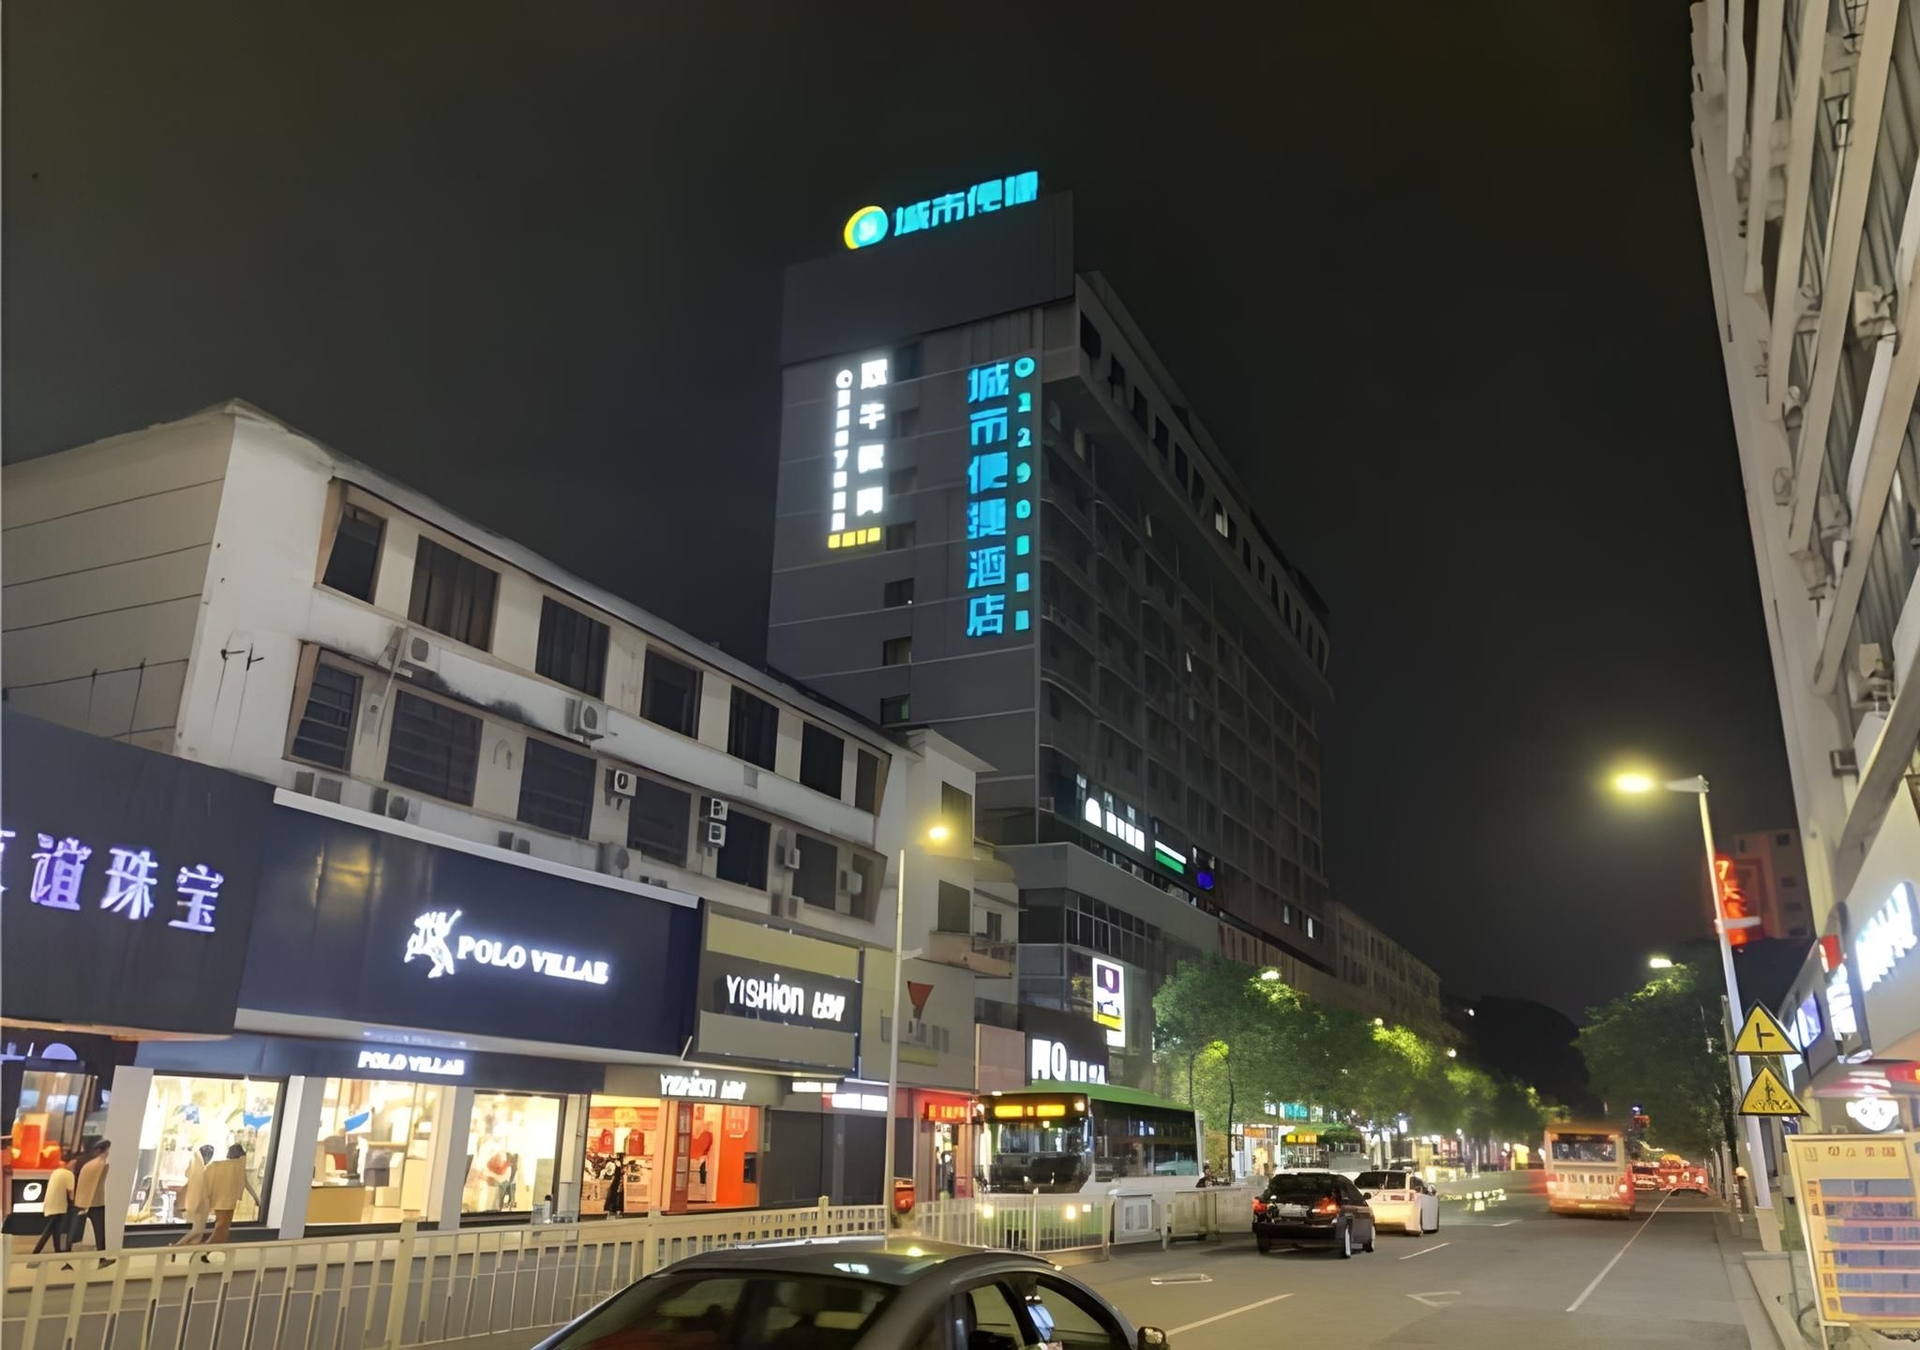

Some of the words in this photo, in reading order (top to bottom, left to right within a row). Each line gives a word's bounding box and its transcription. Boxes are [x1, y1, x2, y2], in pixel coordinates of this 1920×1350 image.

[0, 829, 224, 933] 谊珠宝
[456, 935, 527, 970] POLO
